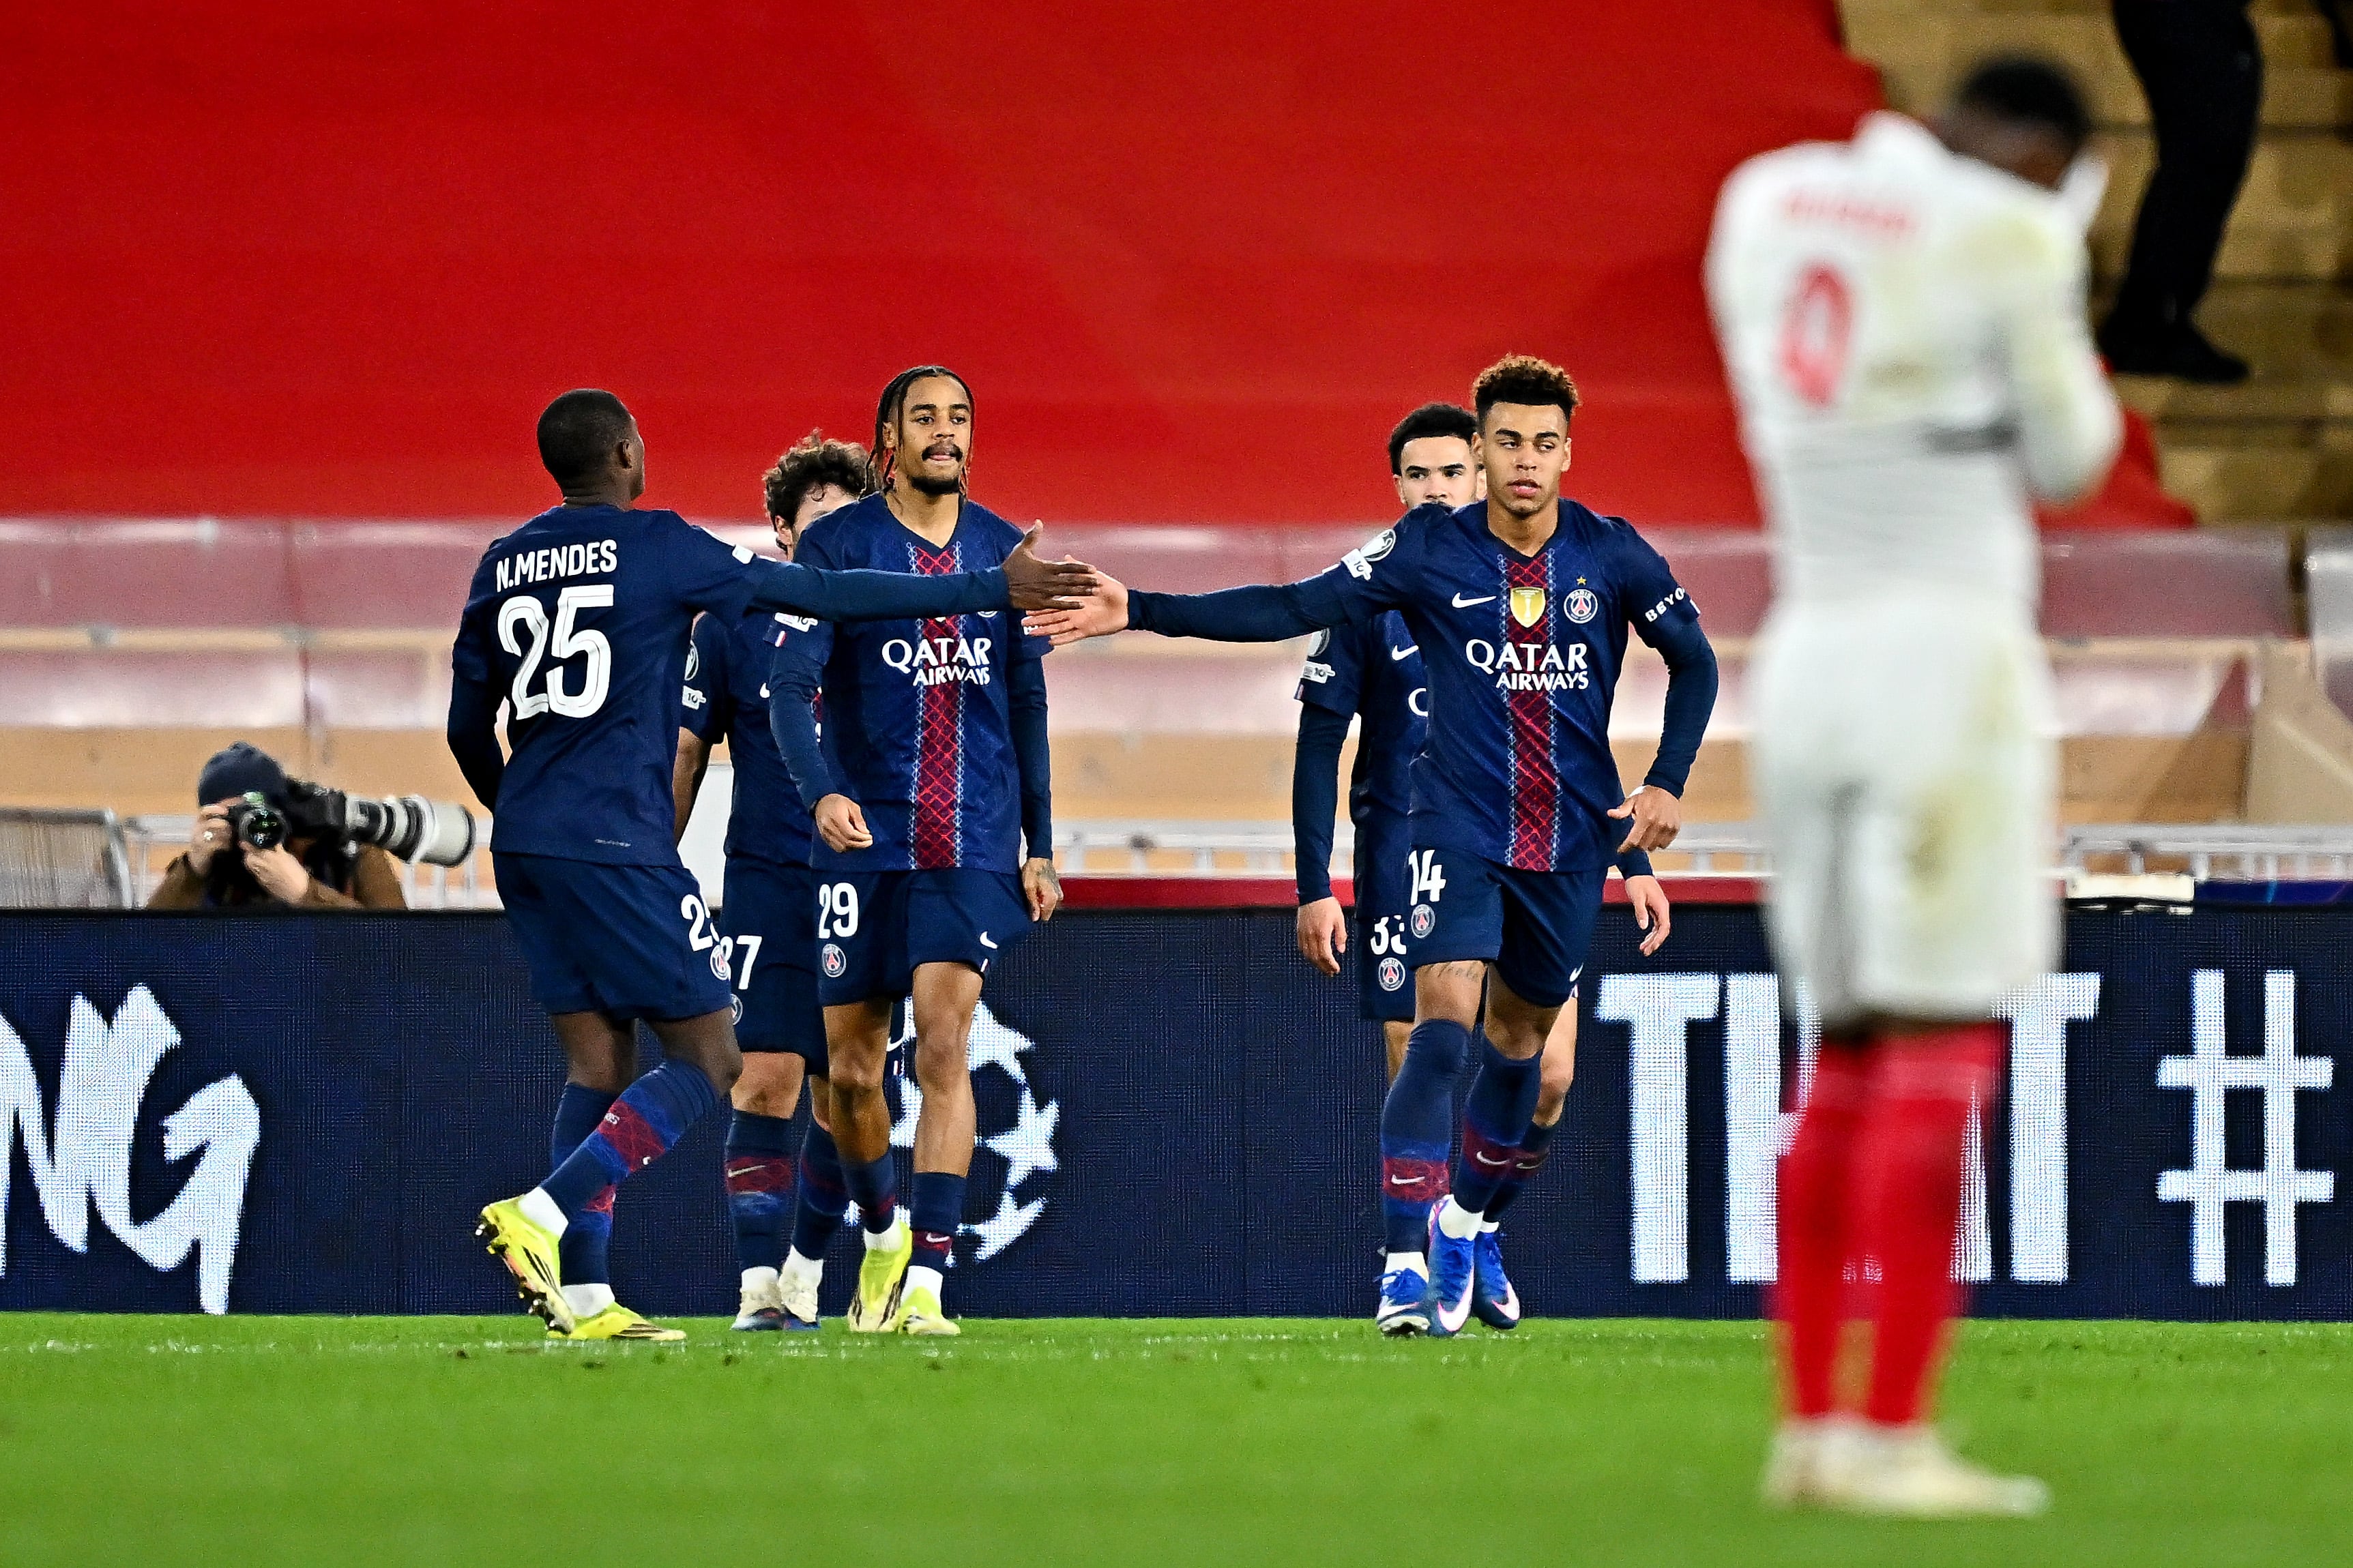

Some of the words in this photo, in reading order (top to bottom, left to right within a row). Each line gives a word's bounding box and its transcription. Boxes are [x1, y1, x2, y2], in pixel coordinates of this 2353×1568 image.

[496, 539, 618, 593] N.MENDES
[1645, 587, 1685, 622] BEYO
[497, 584, 615, 720] 25
[881, 637, 991, 675] QATAR
[1465, 638, 1588, 675] QATAR
[913, 665, 991, 686] AIRWAYS
[1495, 670, 1590, 691] AIRWAYS
[1407, 848, 1446, 906] 14
[818, 881, 859, 939] 29
[1595, 971, 2101, 1285] THT
